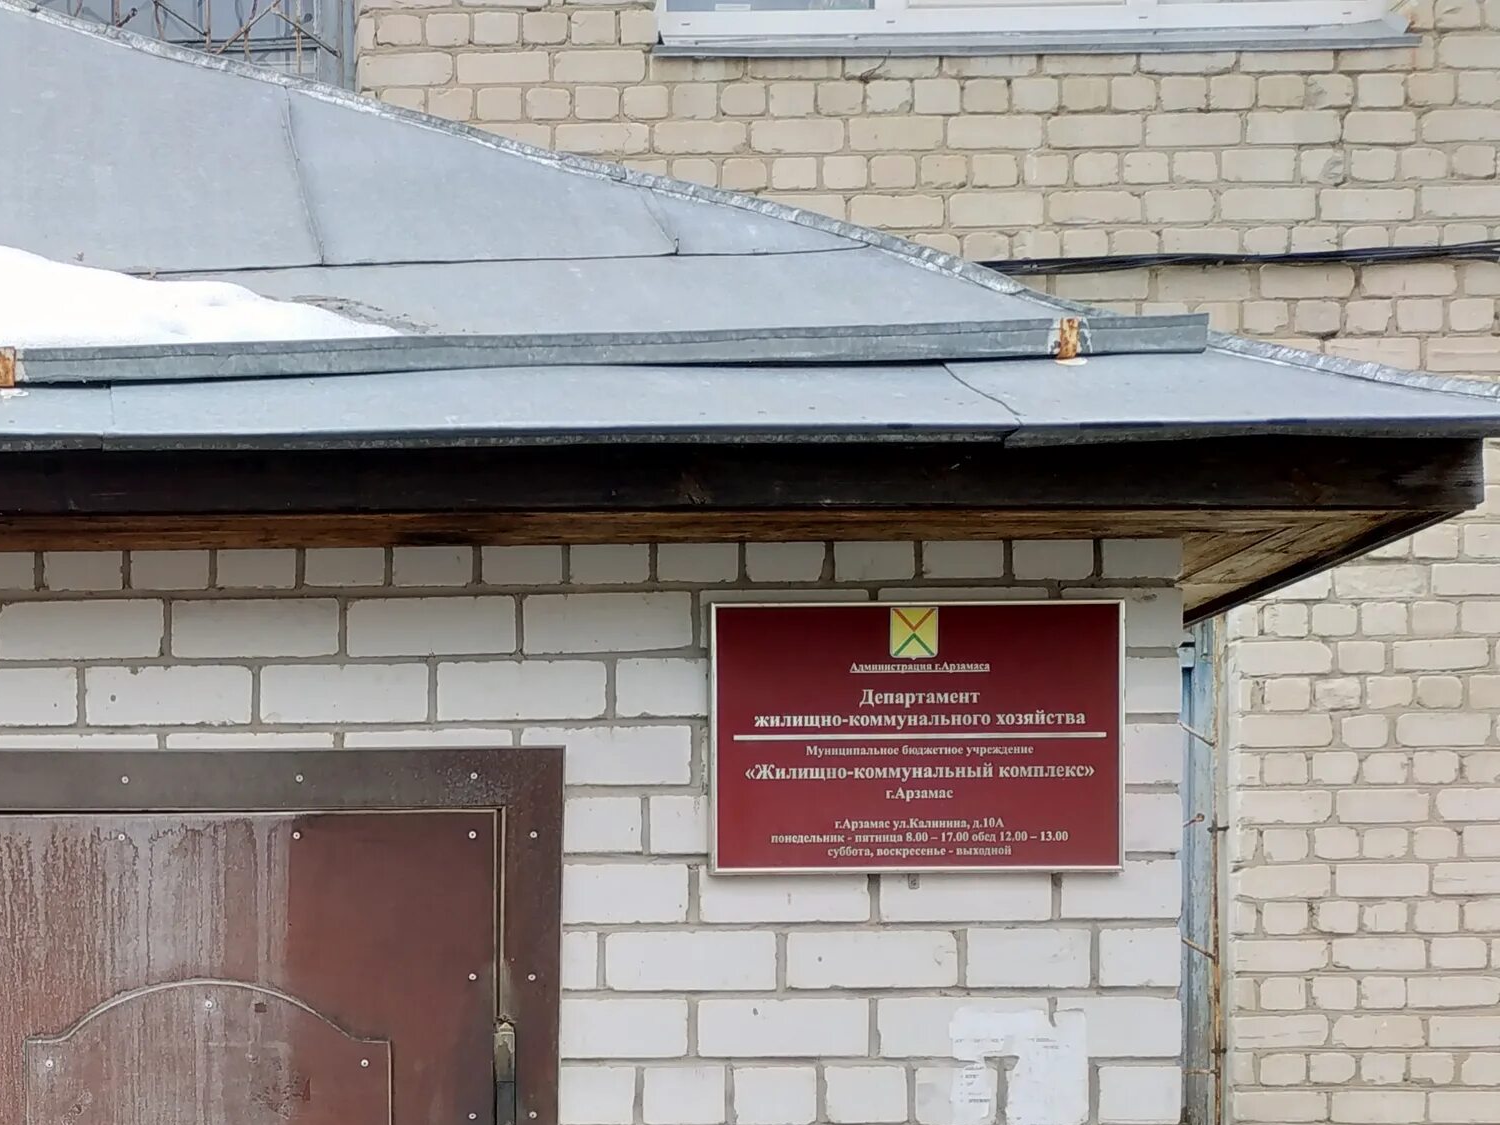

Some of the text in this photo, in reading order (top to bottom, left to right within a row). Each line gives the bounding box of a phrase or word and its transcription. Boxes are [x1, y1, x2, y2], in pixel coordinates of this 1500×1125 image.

[850, 662, 990, 673] Администрация г.Арзамаса
[859, 688, 980, 708] Департамент
[754, 710, 1086, 730] жилищно-коммунального хозяйства
[806, 745, 1034, 758] Муниципальное бюджетное учреждение
[745, 763, 1095, 782] «Жилищно-коммунальный комплекс»
[886, 787, 954, 801] г.Арзамас
[835, 817, 1004, 831] г.Арзамас ул.Калинина, д.10А
[771, 834, 845, 844] понедельник
[855, 833, 903, 843] пятница
[905, 832, 928, 842] 8.00
[941, 832, 968, 842] 17.00
[971, 832, 996, 842] обед
[999, 831, 1028, 842] 12.00
[1040, 831, 1068, 841] 13.00
[827, 847, 874, 859] суббота,
[876, 847, 946, 858] воскресенье
[956, 846, 1012, 856] выходной
